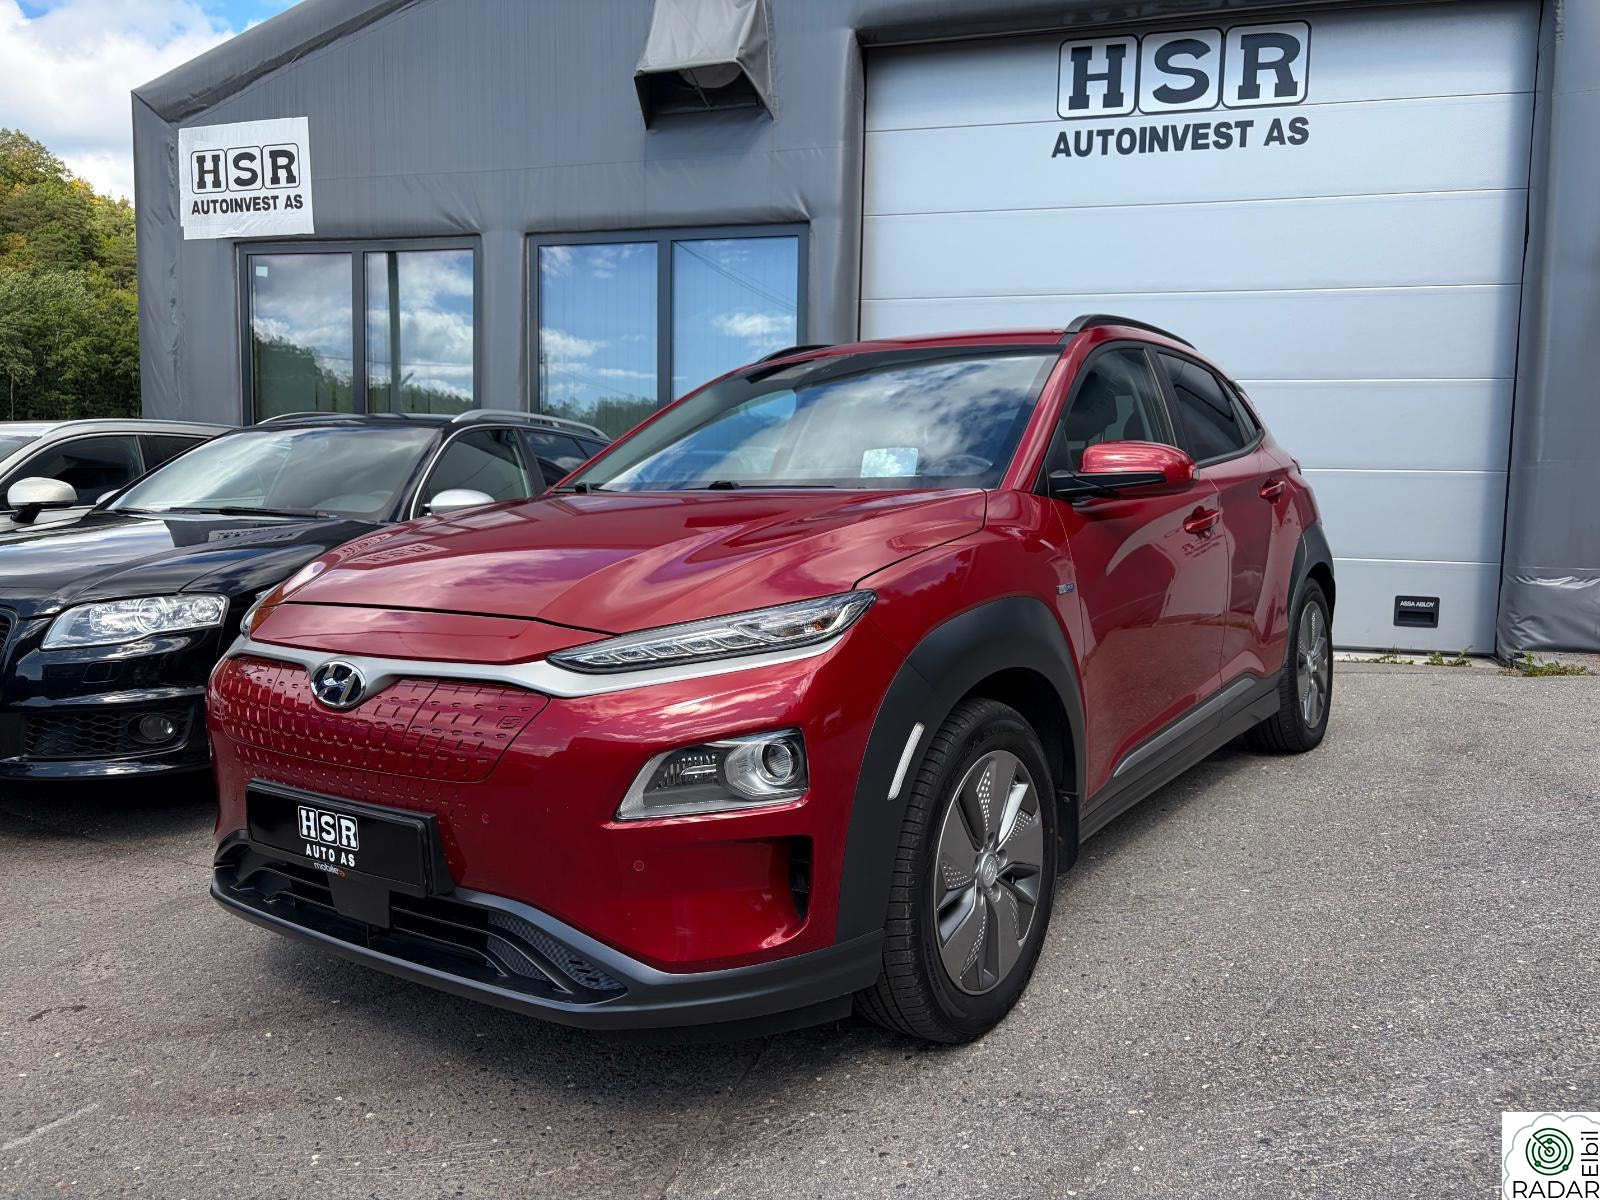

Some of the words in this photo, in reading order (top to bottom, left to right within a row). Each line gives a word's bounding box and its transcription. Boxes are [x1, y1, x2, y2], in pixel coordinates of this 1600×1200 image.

[1067, 31, 1302, 111] HSR
[1051, 119, 1255, 159] AUTOINVEST
[1263, 116, 1310, 147] AS
[195, 148, 298, 190] HSR
[191, 195, 279, 215] AUTOINVEST
[284, 194, 304, 210] AS
[300, 809, 357, 848] HSR
[305, 843, 336, 862] AUTO
[340, 851, 356, 868] AS
